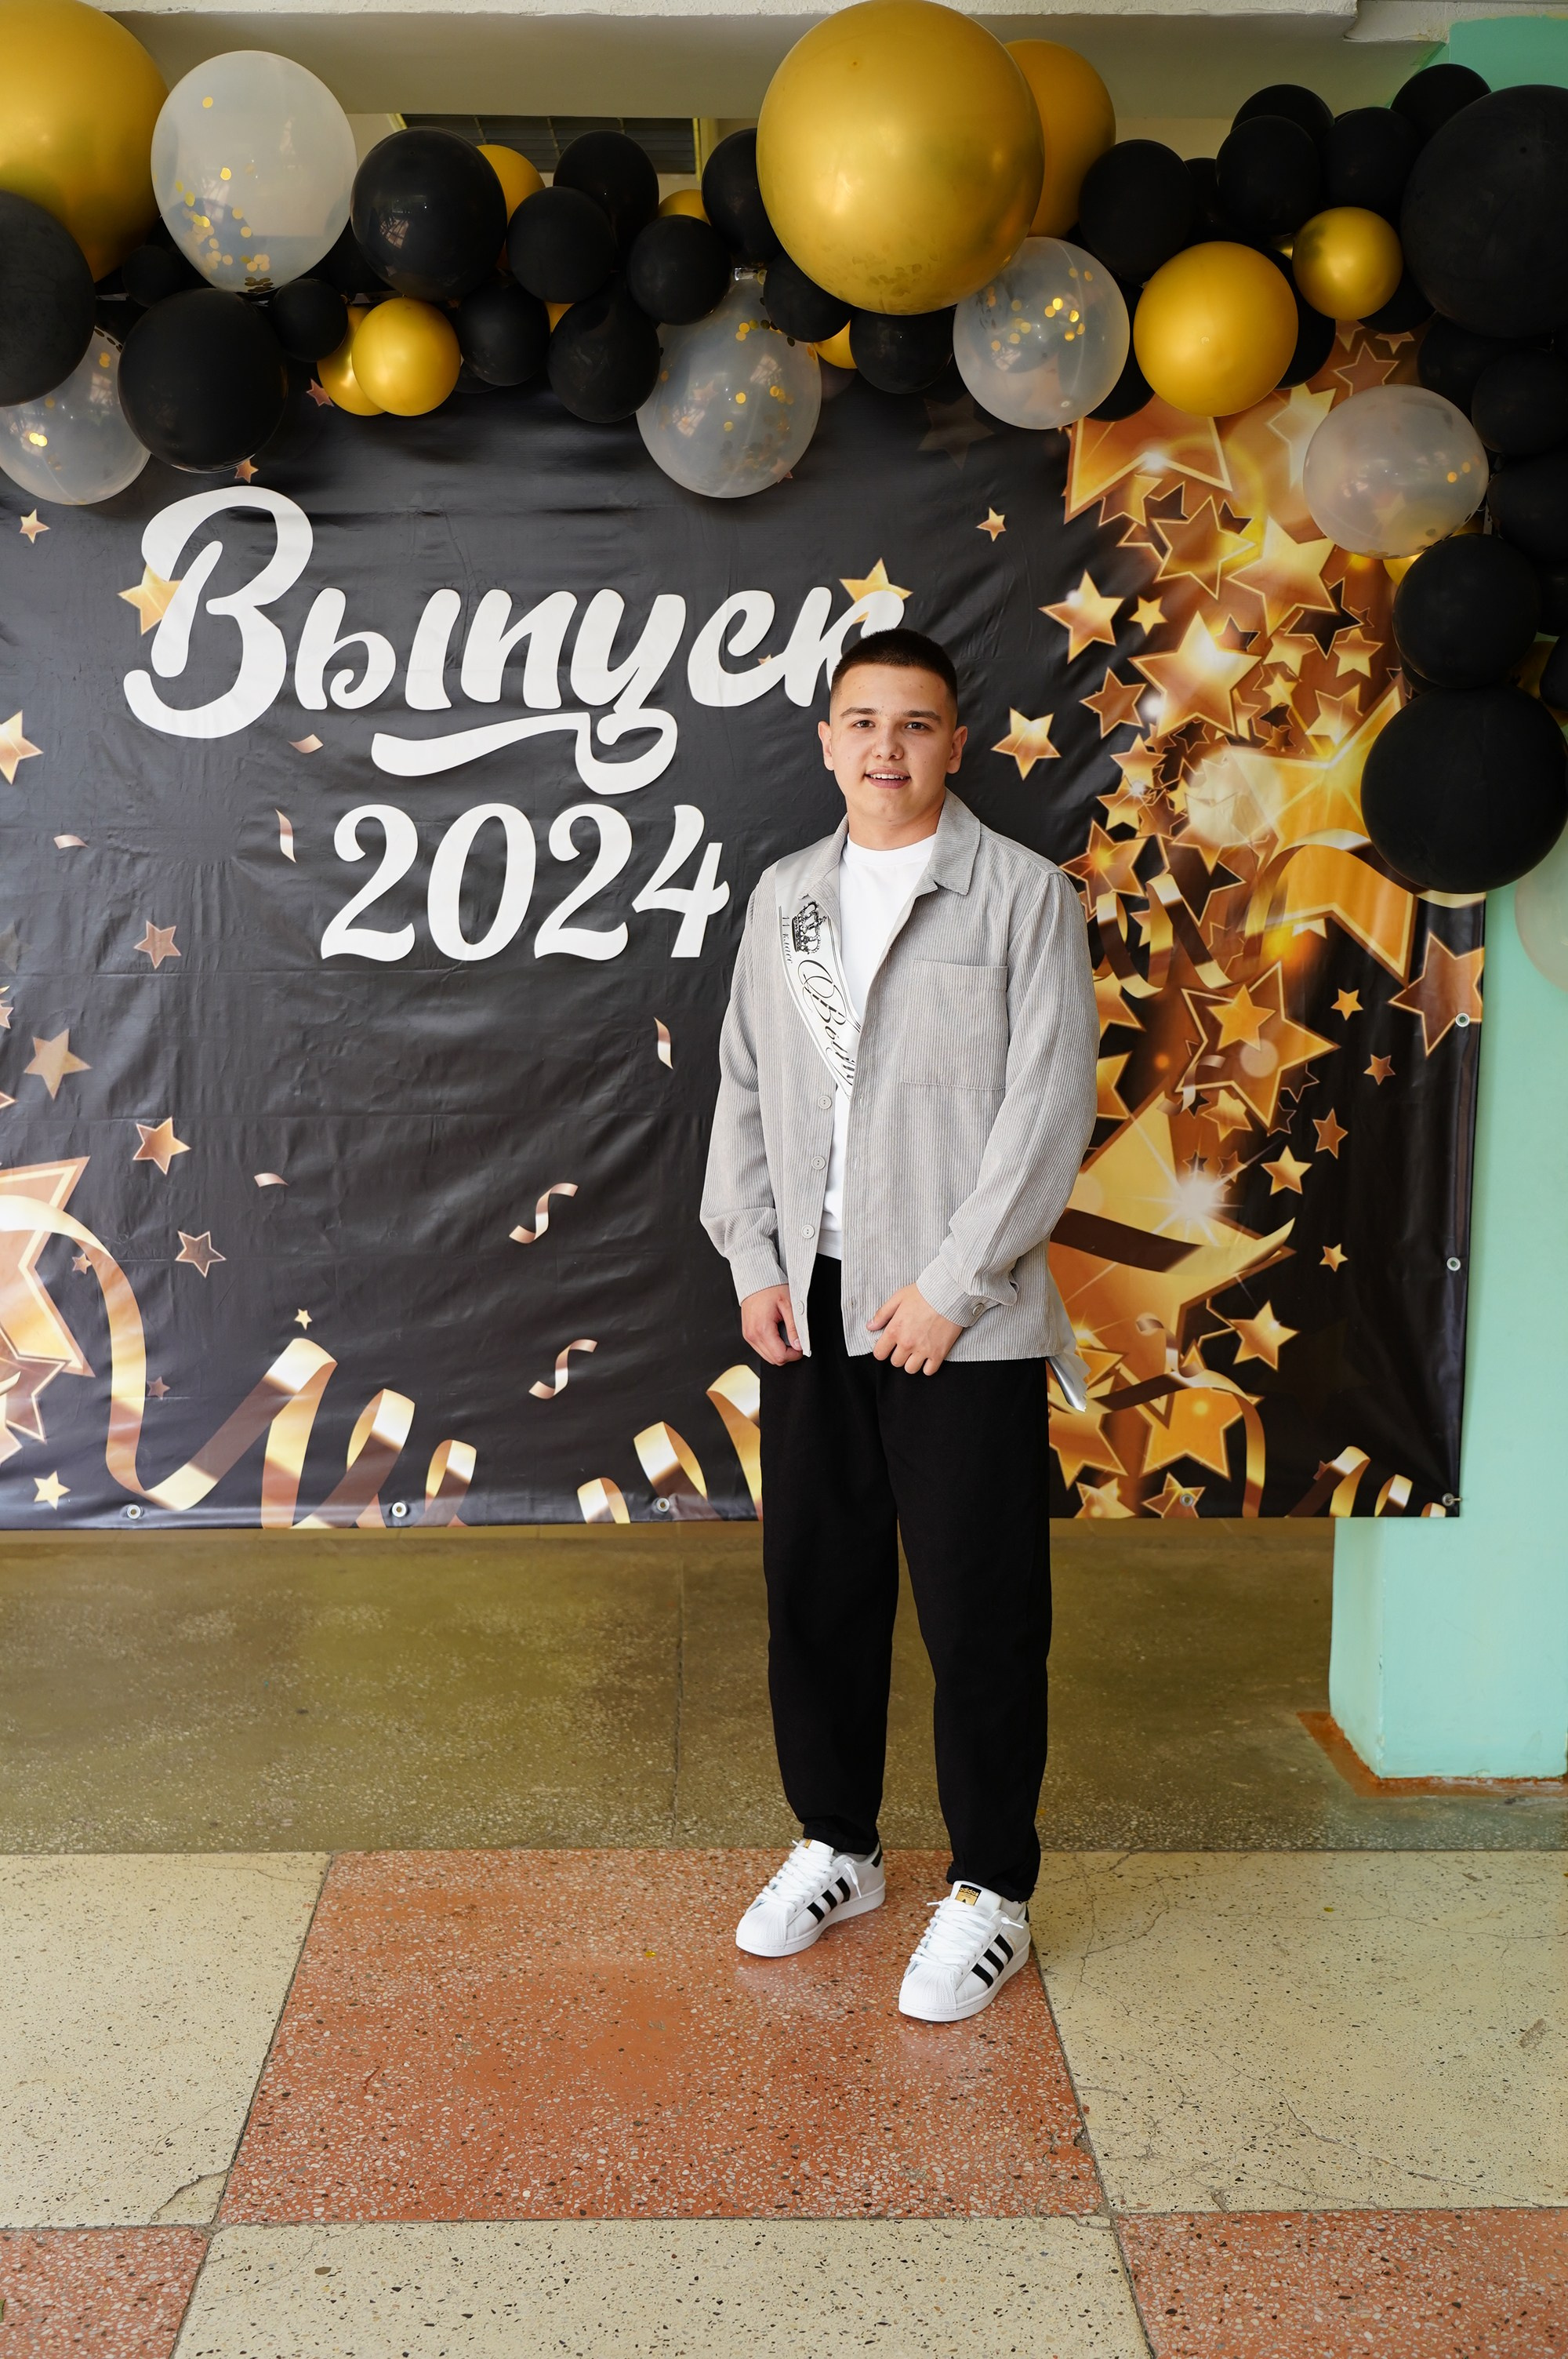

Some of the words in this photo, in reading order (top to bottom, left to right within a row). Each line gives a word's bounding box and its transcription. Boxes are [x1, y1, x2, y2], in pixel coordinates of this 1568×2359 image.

[123, 485, 905, 794] Выпуск
[321, 803, 730, 962] 2024
[782, 916, 790, 927] 11
[960, 1887, 979, 1897] adidas
